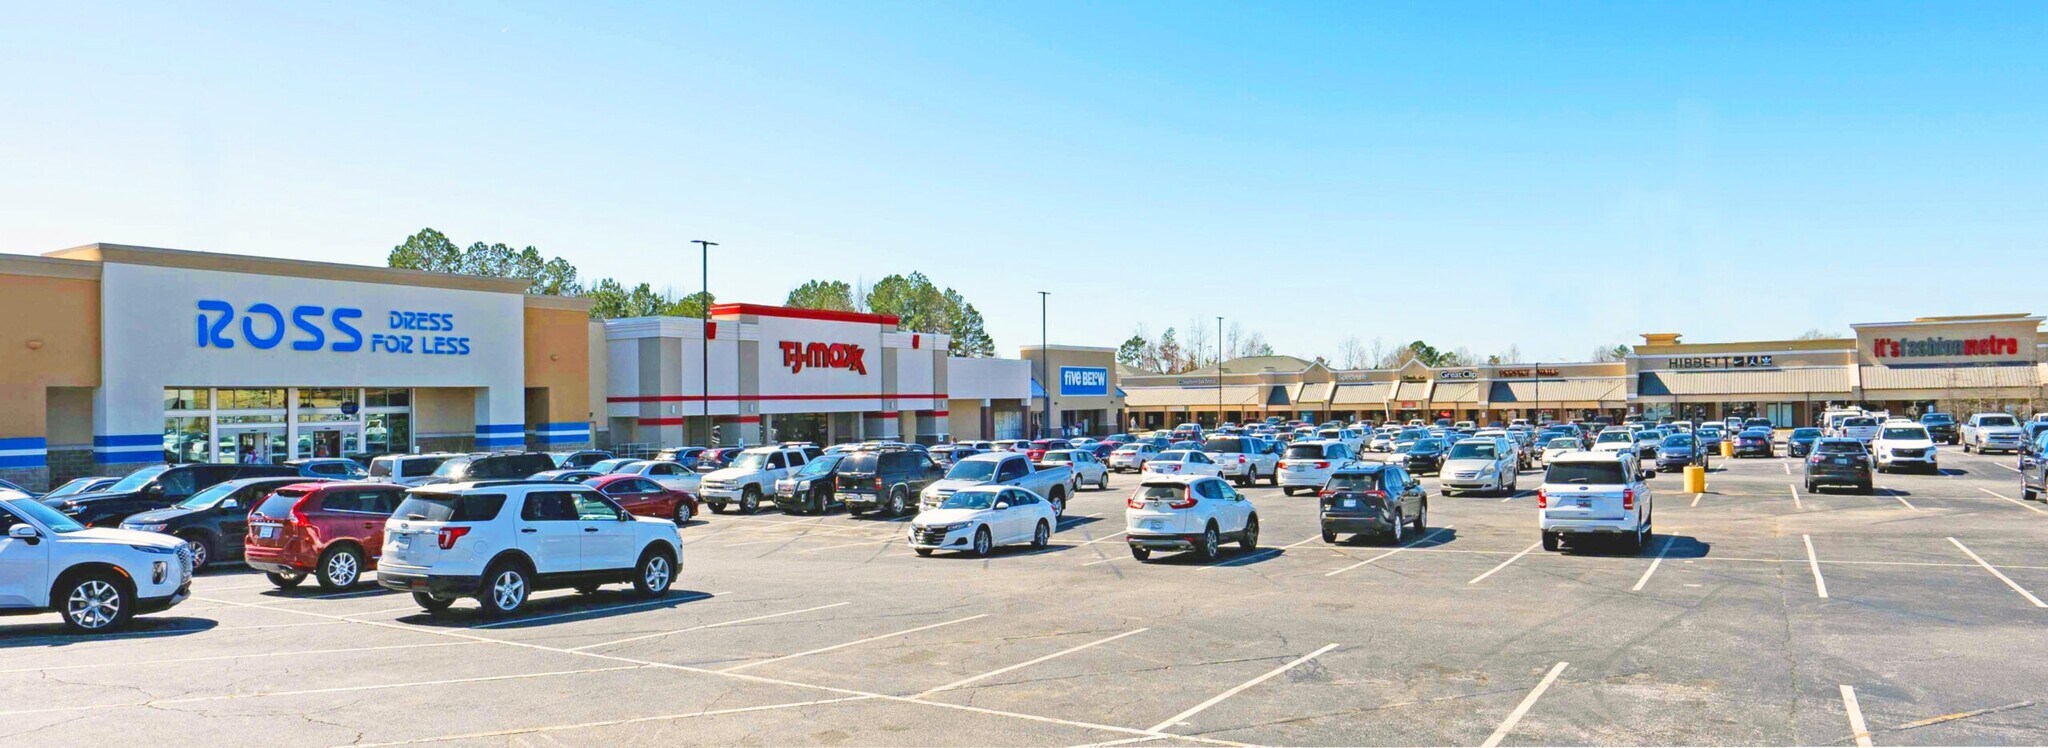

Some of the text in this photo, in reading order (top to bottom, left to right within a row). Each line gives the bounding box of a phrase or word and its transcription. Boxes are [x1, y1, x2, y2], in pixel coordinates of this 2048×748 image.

[197, 300, 363, 351] ROSS
[389, 310, 453, 331] DRESS
[371, 334, 470, 355] FOR LESS
[1669, 356, 1731, 369] HIBBETT
[1064, 371, 1081, 386] five
[1441, 371, 1461, 379] Great
